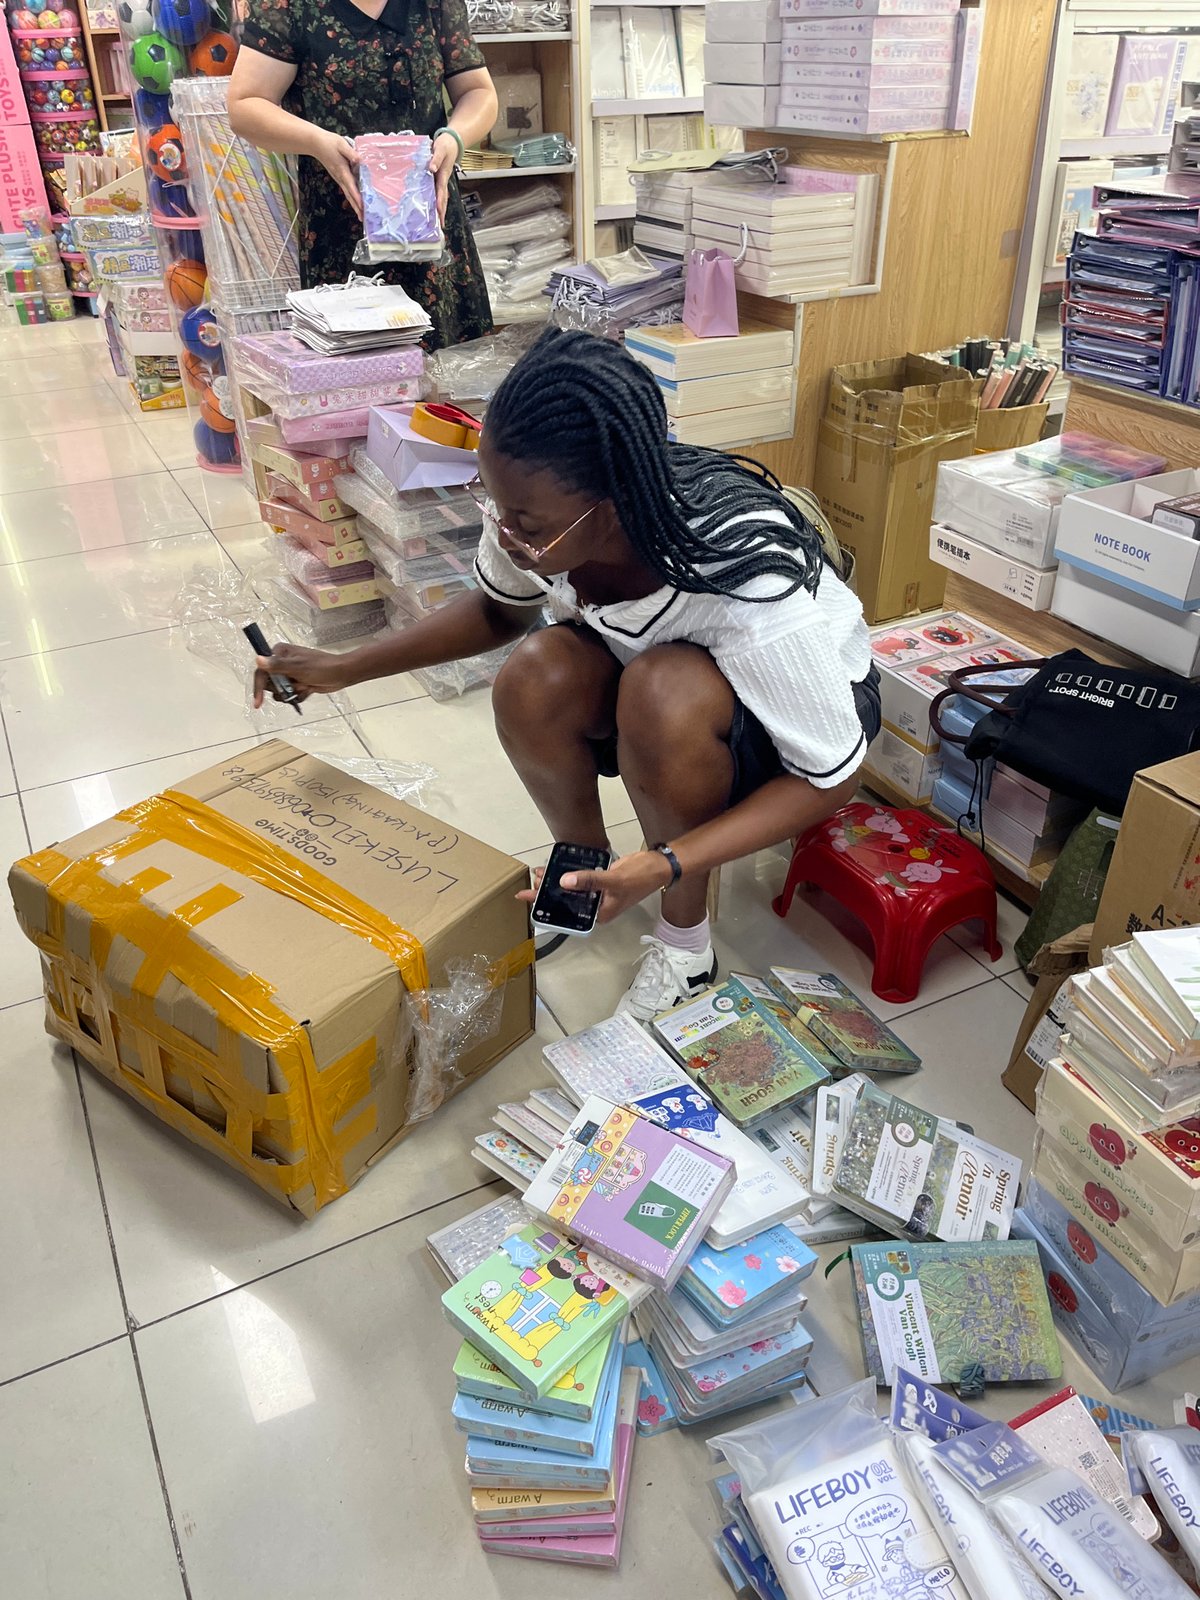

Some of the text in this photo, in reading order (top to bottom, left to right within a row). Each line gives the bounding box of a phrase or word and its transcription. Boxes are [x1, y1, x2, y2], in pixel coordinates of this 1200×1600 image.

[1094, 533, 1120, 551] NOTE
[1122, 543, 1152, 562] BOOK
[1052, 686, 1115, 708] BRIGHT SPOT
[309, 813, 460, 894] LUSEKELO
[739, 1068, 803, 1107] VAN GOGH
[823, 1134, 837, 1176] Spring
[1060, 1125, 1099, 1166] apple
[908, 1155, 923, 1184] Spring
[955, 1150, 979, 1220] Renoir
[982, 1162, 994, 1179] In
[990, 1169, 1011, 1214] Spring
[1055, 1182, 1094, 1222] apple
[664, 1207, 692, 1241] ZIPPER LOCK
[465, 1302, 499, 1334] A warm
[474, 1292, 496, 1314] nest
[899, 1309, 918, 1361] Van Gogh
[481, 1400, 526, 1418] A warm
[775, 1465, 872, 1524] LIFEBOY
[870, 1459, 894, 1476] 01
[877, 1475, 896, 1484] VOL.
[1150, 1456, 1200, 1528] LIFEBOY
[497, 1493, 543, 1504] A warm
[1040, 1489, 1091, 1526] LIFEBOY
[799, 1525, 812, 1535] REC
[1018, 1528, 1085, 1597] LIFEBOY
